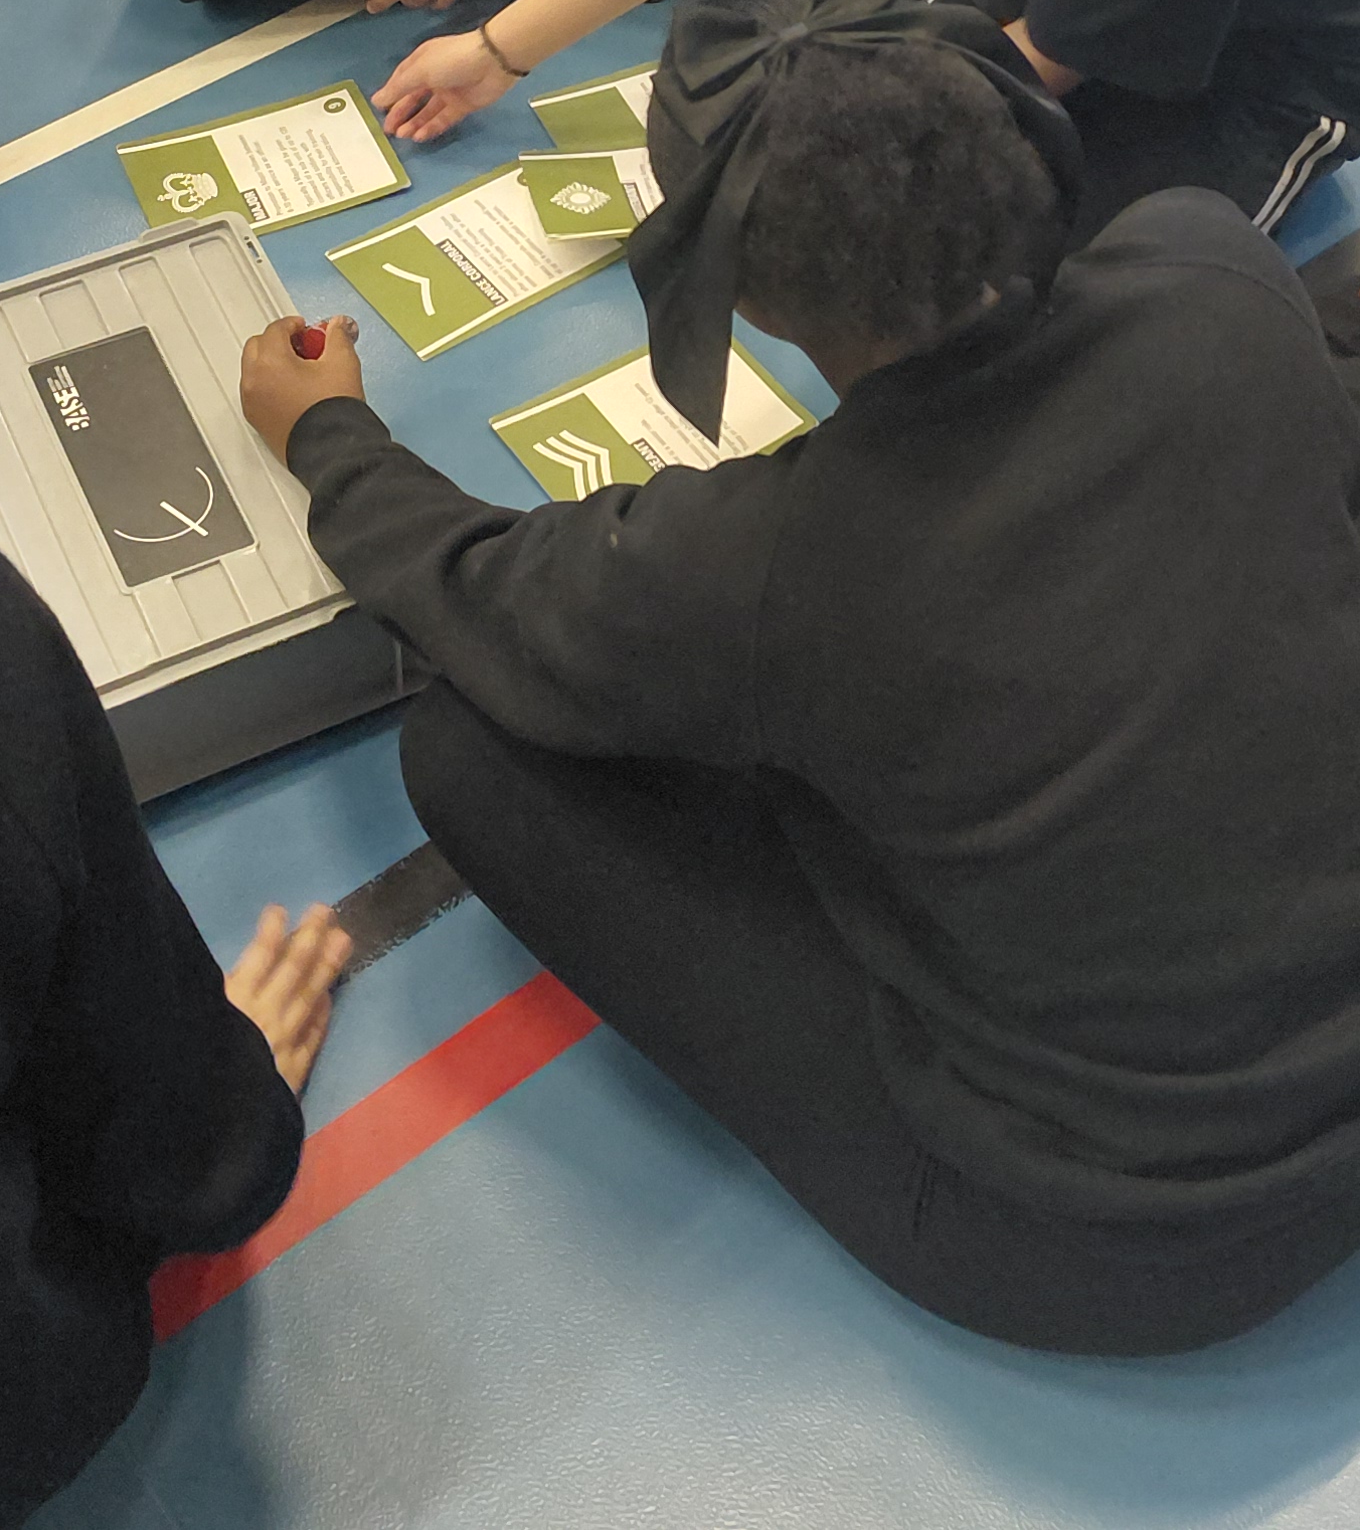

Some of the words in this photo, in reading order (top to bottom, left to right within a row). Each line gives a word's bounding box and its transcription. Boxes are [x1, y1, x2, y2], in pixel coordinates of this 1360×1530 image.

[243, 190, 266, 221] MAJOR
[439, 239, 482, 282] CORPORAL
[475, 277, 505, 306] LANCE
[53, 385, 91, 432] BASE
